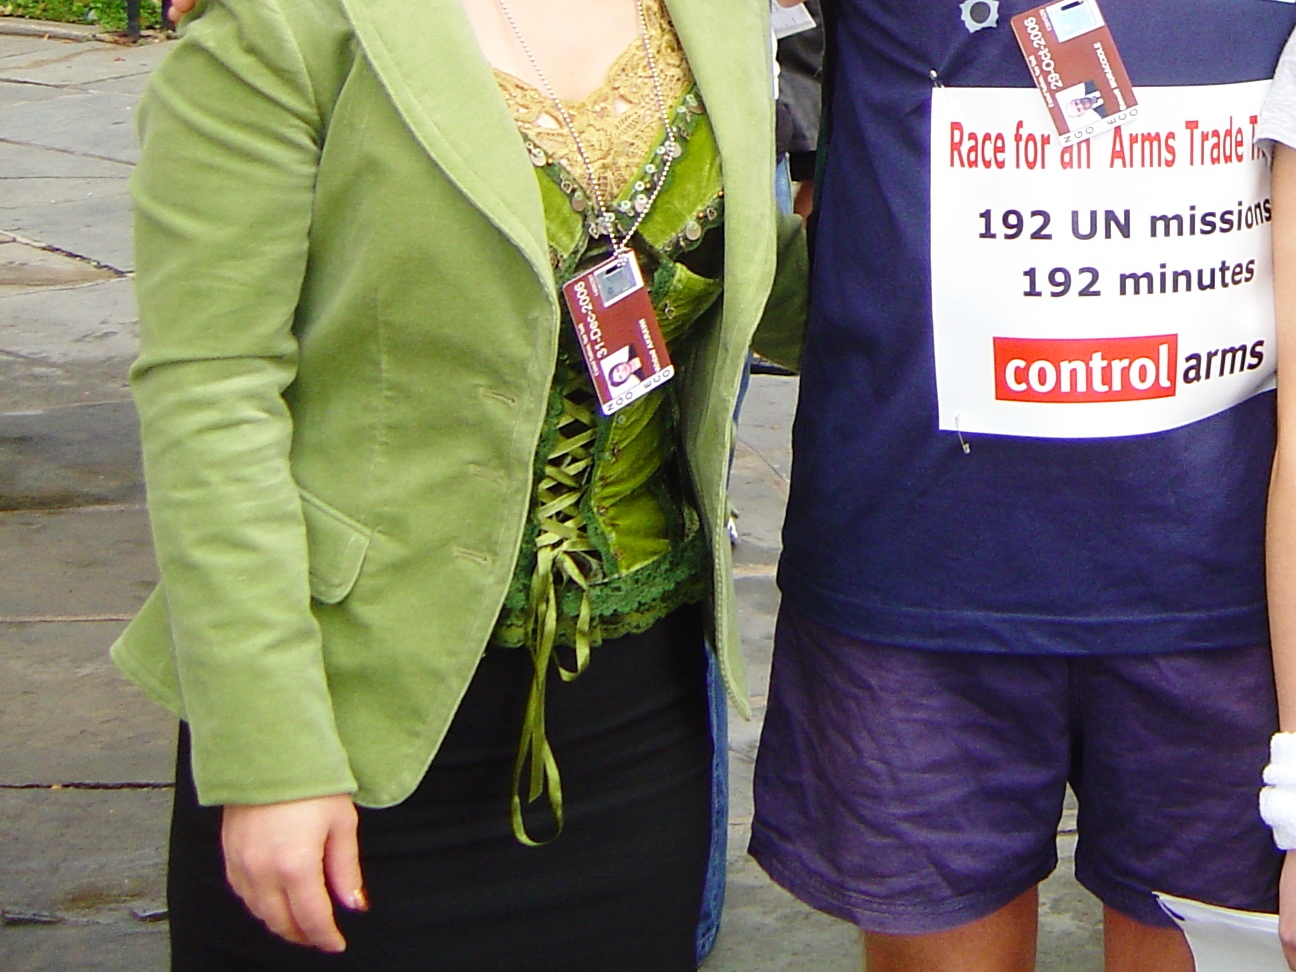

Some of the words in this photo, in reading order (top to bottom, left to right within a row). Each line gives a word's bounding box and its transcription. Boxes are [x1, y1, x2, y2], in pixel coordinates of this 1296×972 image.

[1024, 16, 1063, 89] 29-Oct-2006
[950, 121, 1006, 169] Race
[1014, 120, 1050, 169] for
[1060, 137, 1091, 169] an
[1109, 124, 1176, 169] Arms
[1185, 116, 1244, 167] Trade
[978, 208, 1053, 241] 192
[1071, 208, 1131, 241] UN
[1150, 197, 1272, 238] missions
[1022, 267, 1101, 297] 192
[1119, 257, 1256, 296] minutes
[574, 281, 607, 359] 31-Dec-2006
[1005, 343, 1171, 393] control
[1182, 339, 1265, 384] arms
